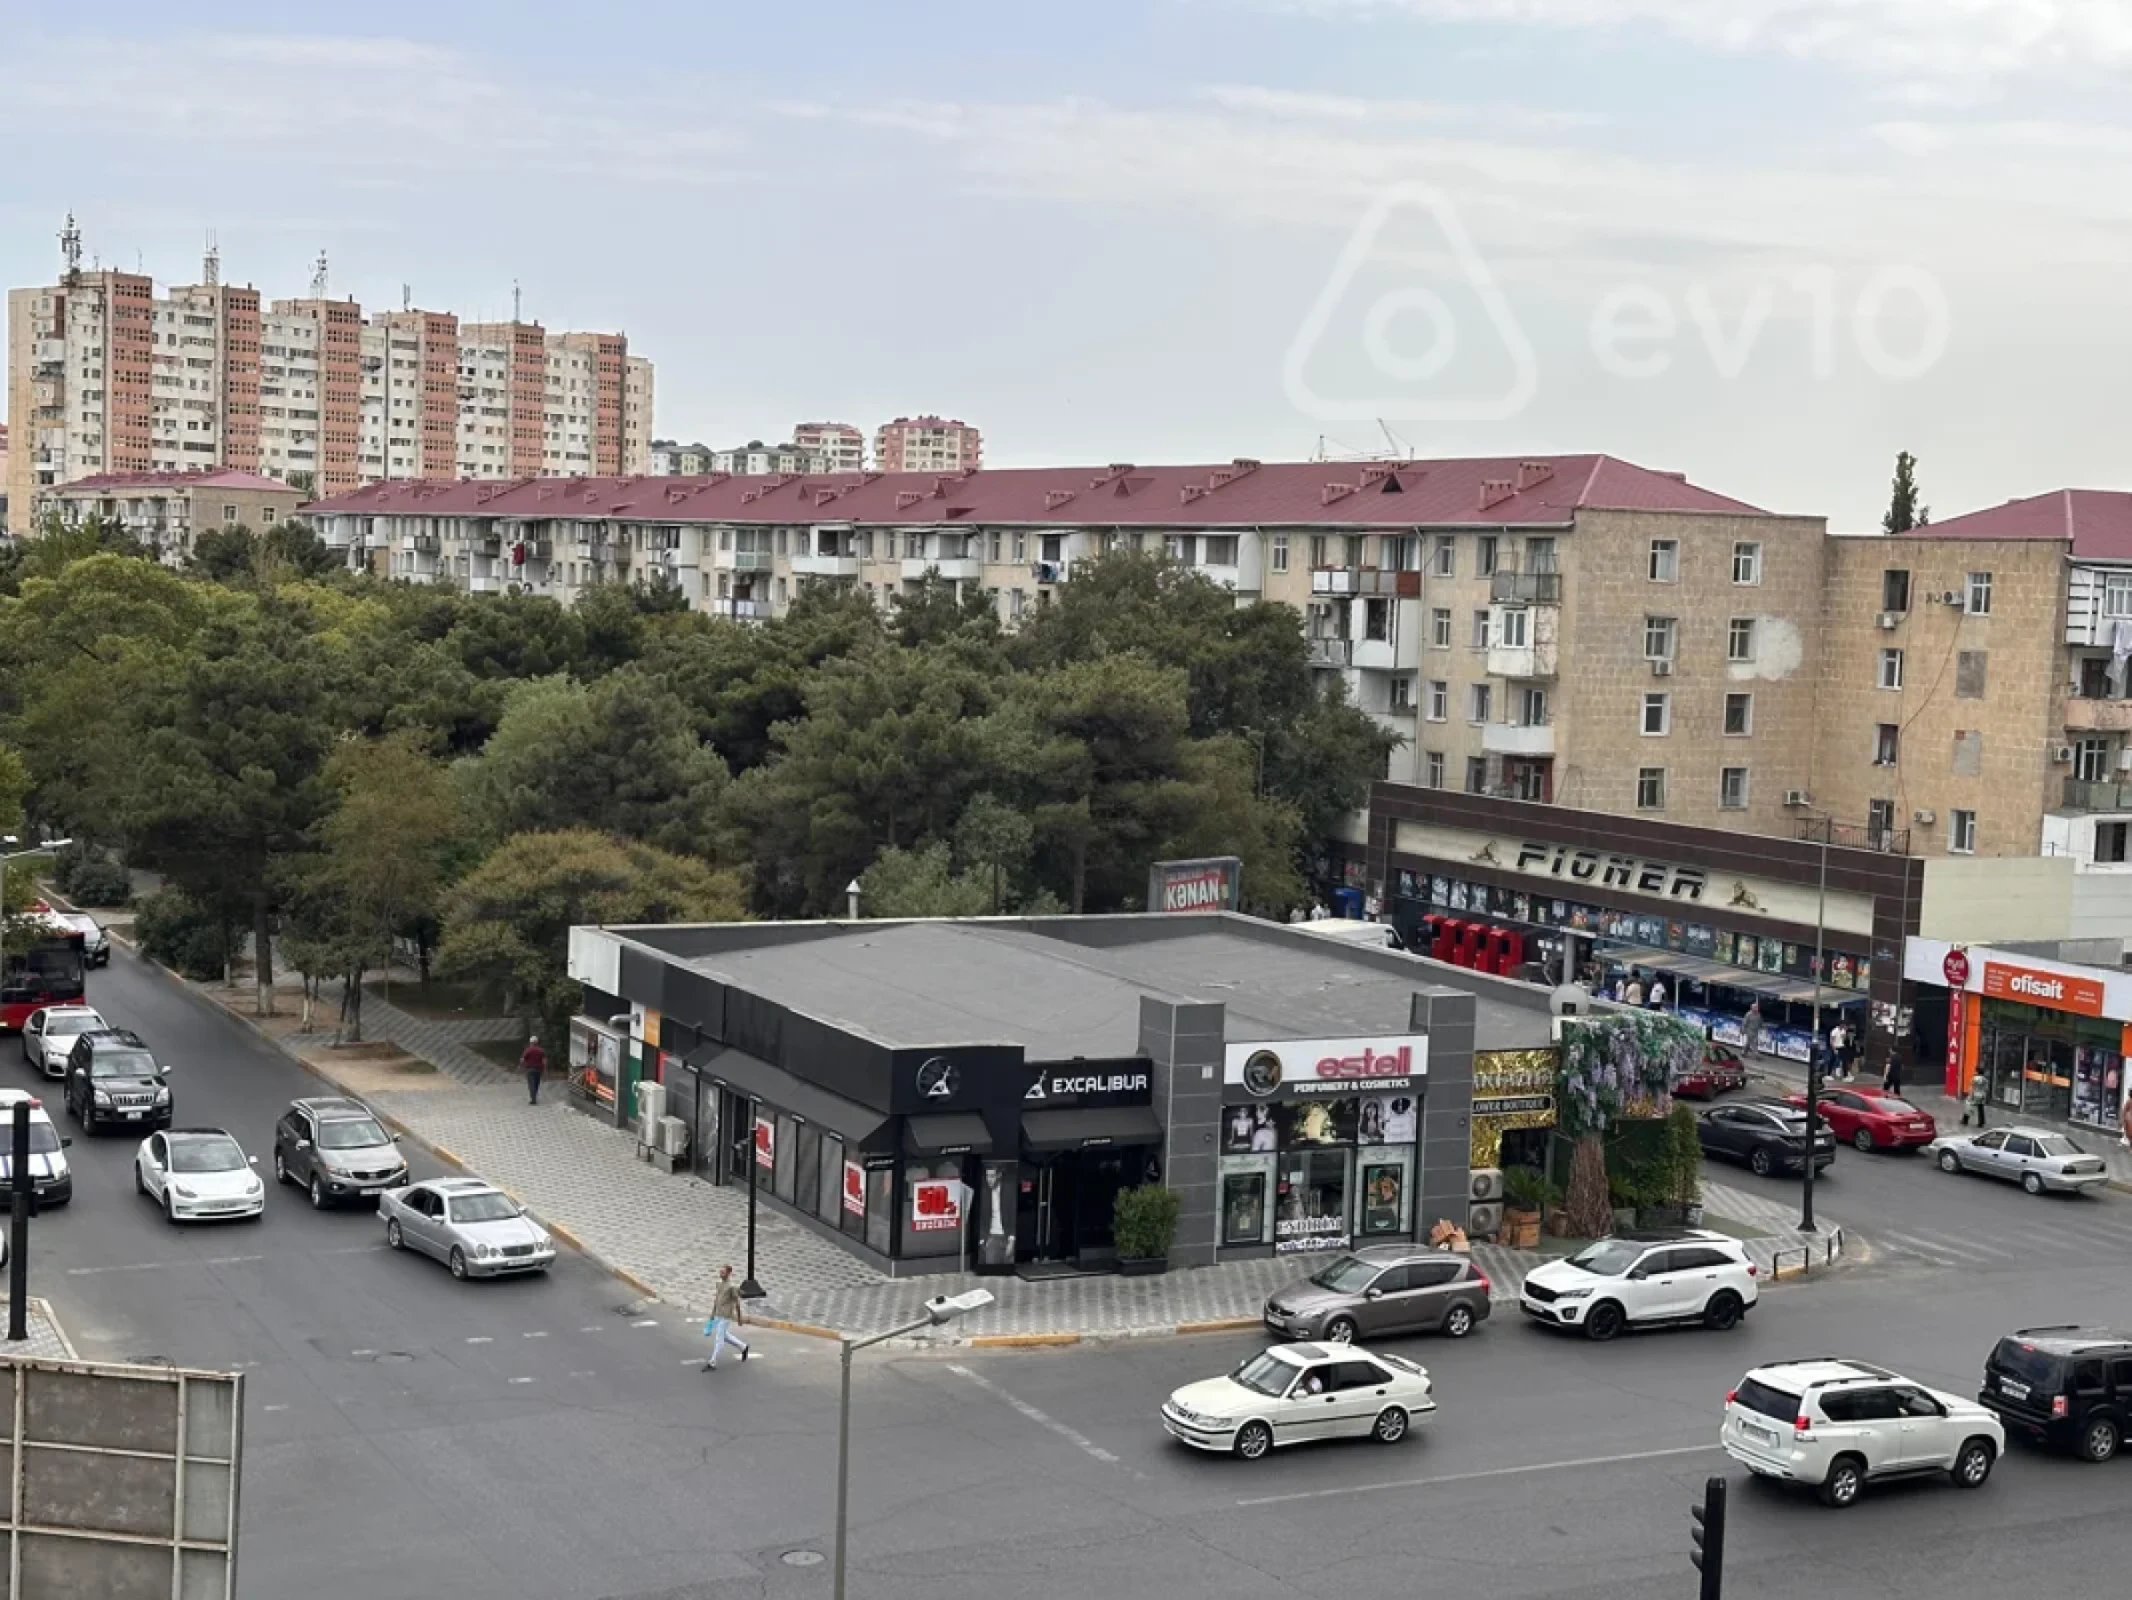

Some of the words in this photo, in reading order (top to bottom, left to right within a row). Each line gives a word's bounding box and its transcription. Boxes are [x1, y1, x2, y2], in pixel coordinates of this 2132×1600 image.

[2010, 974, 2065, 1000] ofisait
[1316, 1046, 1412, 1077] estell
[1052, 1074, 1148, 1094] EXCALIBUR
[1293, 1081, 1349, 1094] PERFUMERY
[1350, 1080, 1359, 1092] &
[1360, 1077, 1411, 1090] COSMETICS
